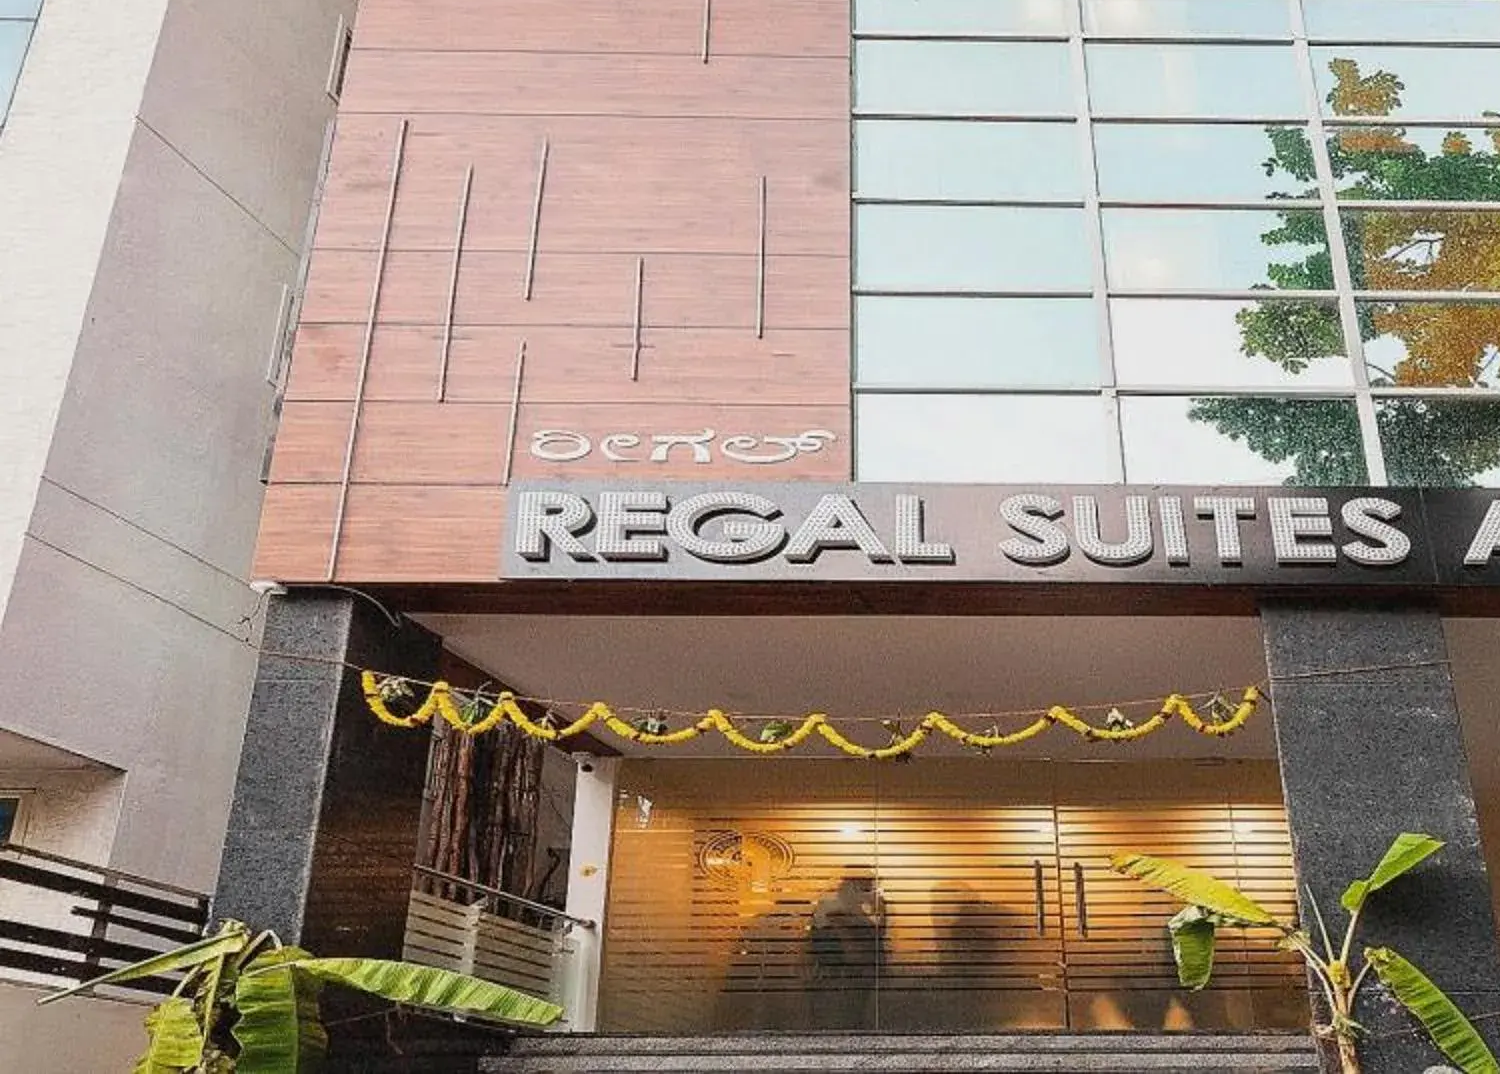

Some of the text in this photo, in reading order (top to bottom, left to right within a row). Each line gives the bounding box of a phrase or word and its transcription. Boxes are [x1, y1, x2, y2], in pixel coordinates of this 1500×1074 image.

[531, 427, 836, 464] ರೀಗಲ್
[514, 490, 955, 564] REGAL
[999, 492, 1412, 566] SUITES
